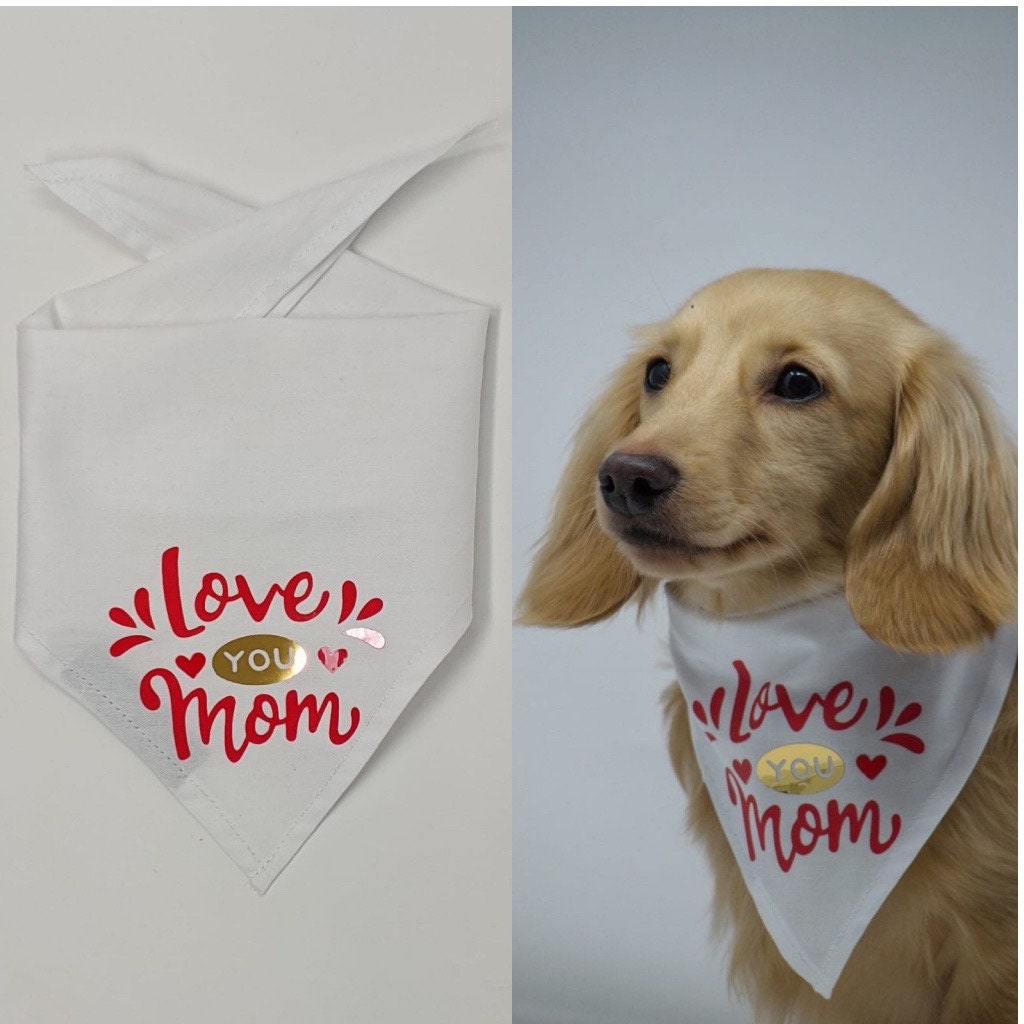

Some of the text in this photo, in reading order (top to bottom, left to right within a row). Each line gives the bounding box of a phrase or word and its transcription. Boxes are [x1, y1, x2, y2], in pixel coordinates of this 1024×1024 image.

[223, 647, 297, 673] YOU
[139, 667, 361, 763] Mom
[766, 755, 836, 782] YOU
[725, 766, 902, 873] Mom
